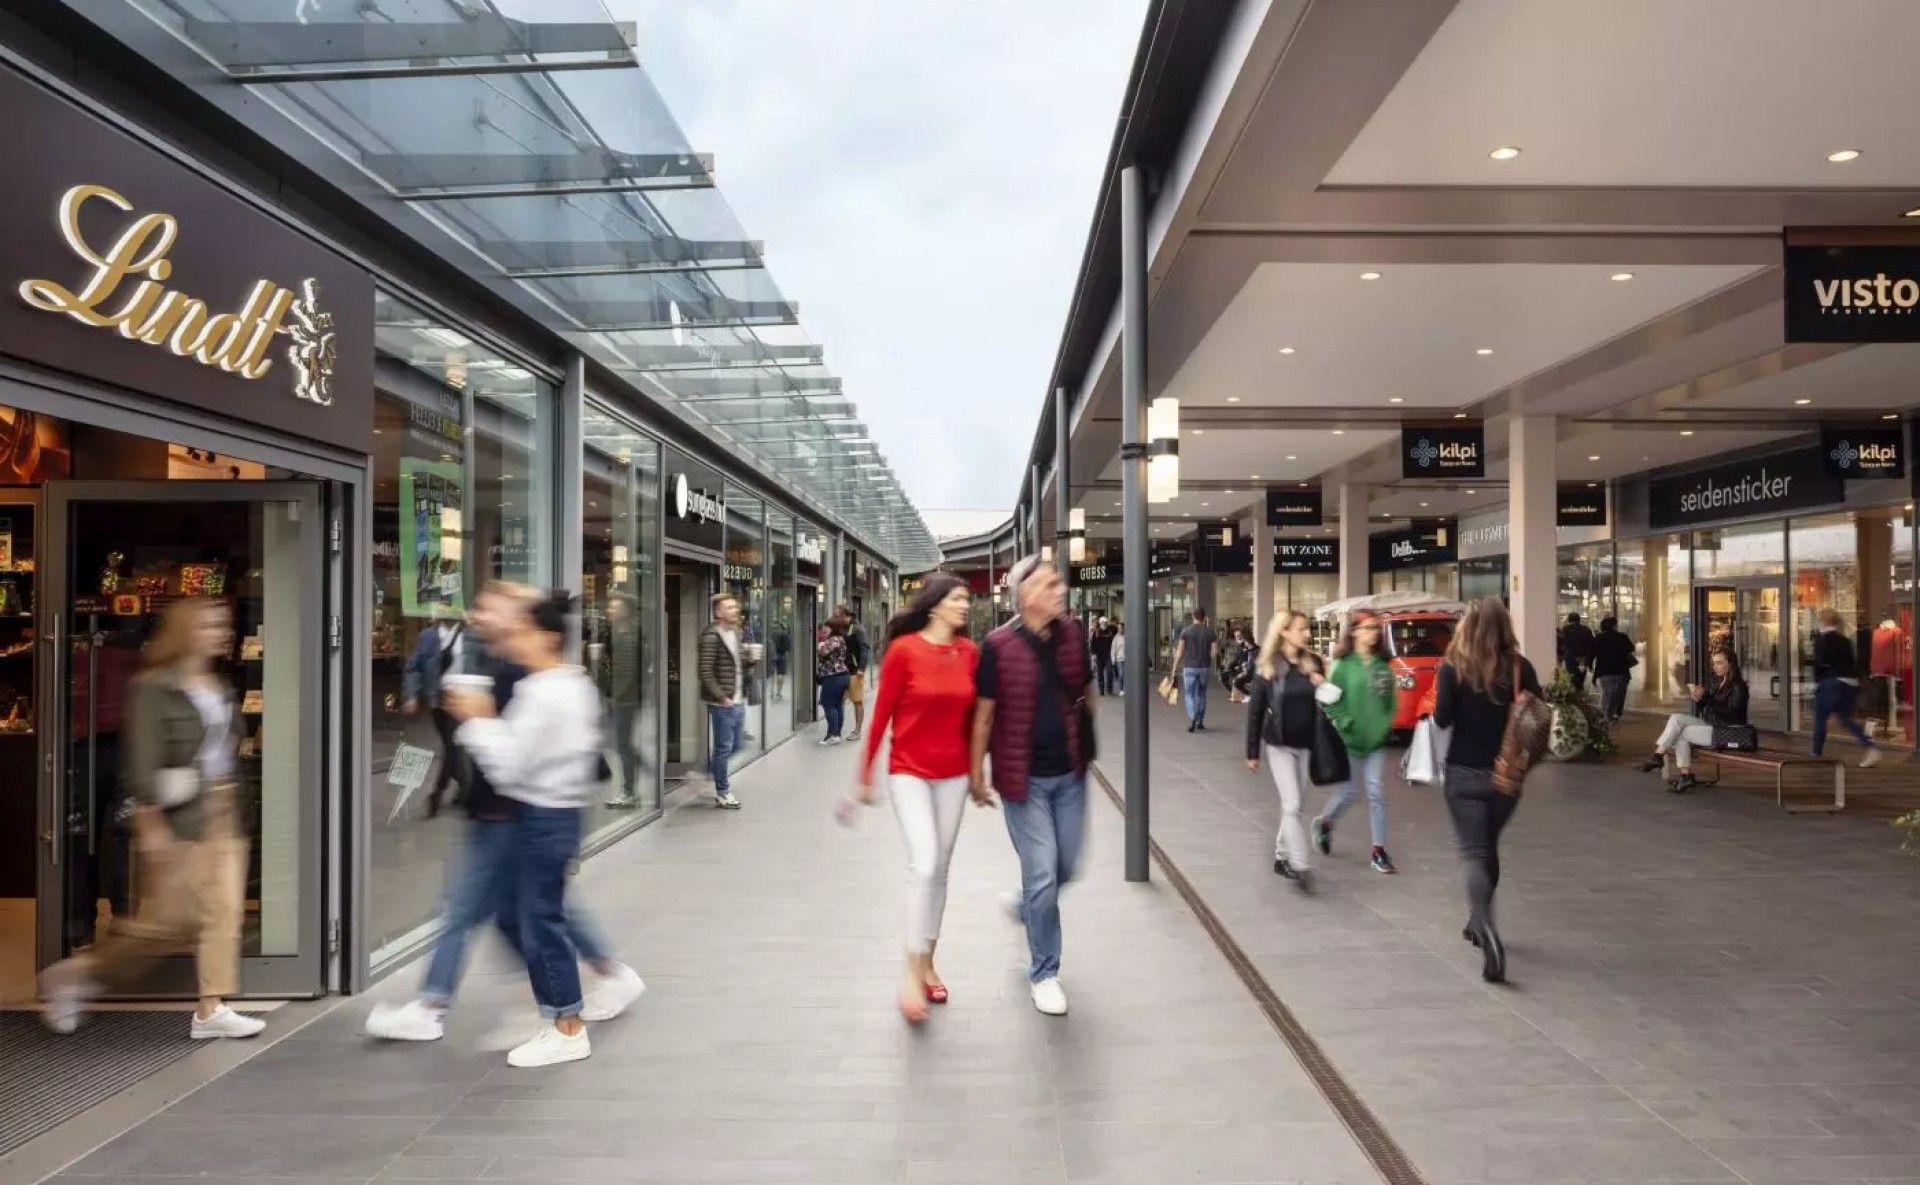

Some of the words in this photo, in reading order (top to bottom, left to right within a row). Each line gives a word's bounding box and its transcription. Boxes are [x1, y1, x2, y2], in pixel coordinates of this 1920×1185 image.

[18, 184, 294, 380] Lindt
[1439, 442, 1477, 460] kilpi
[1859, 443, 1896, 461] kilpi
[1680, 468, 1793, 513] seidensticker
[1299, 545, 1333, 555] ZONE
[1080, 565, 1106, 581] GUESS
